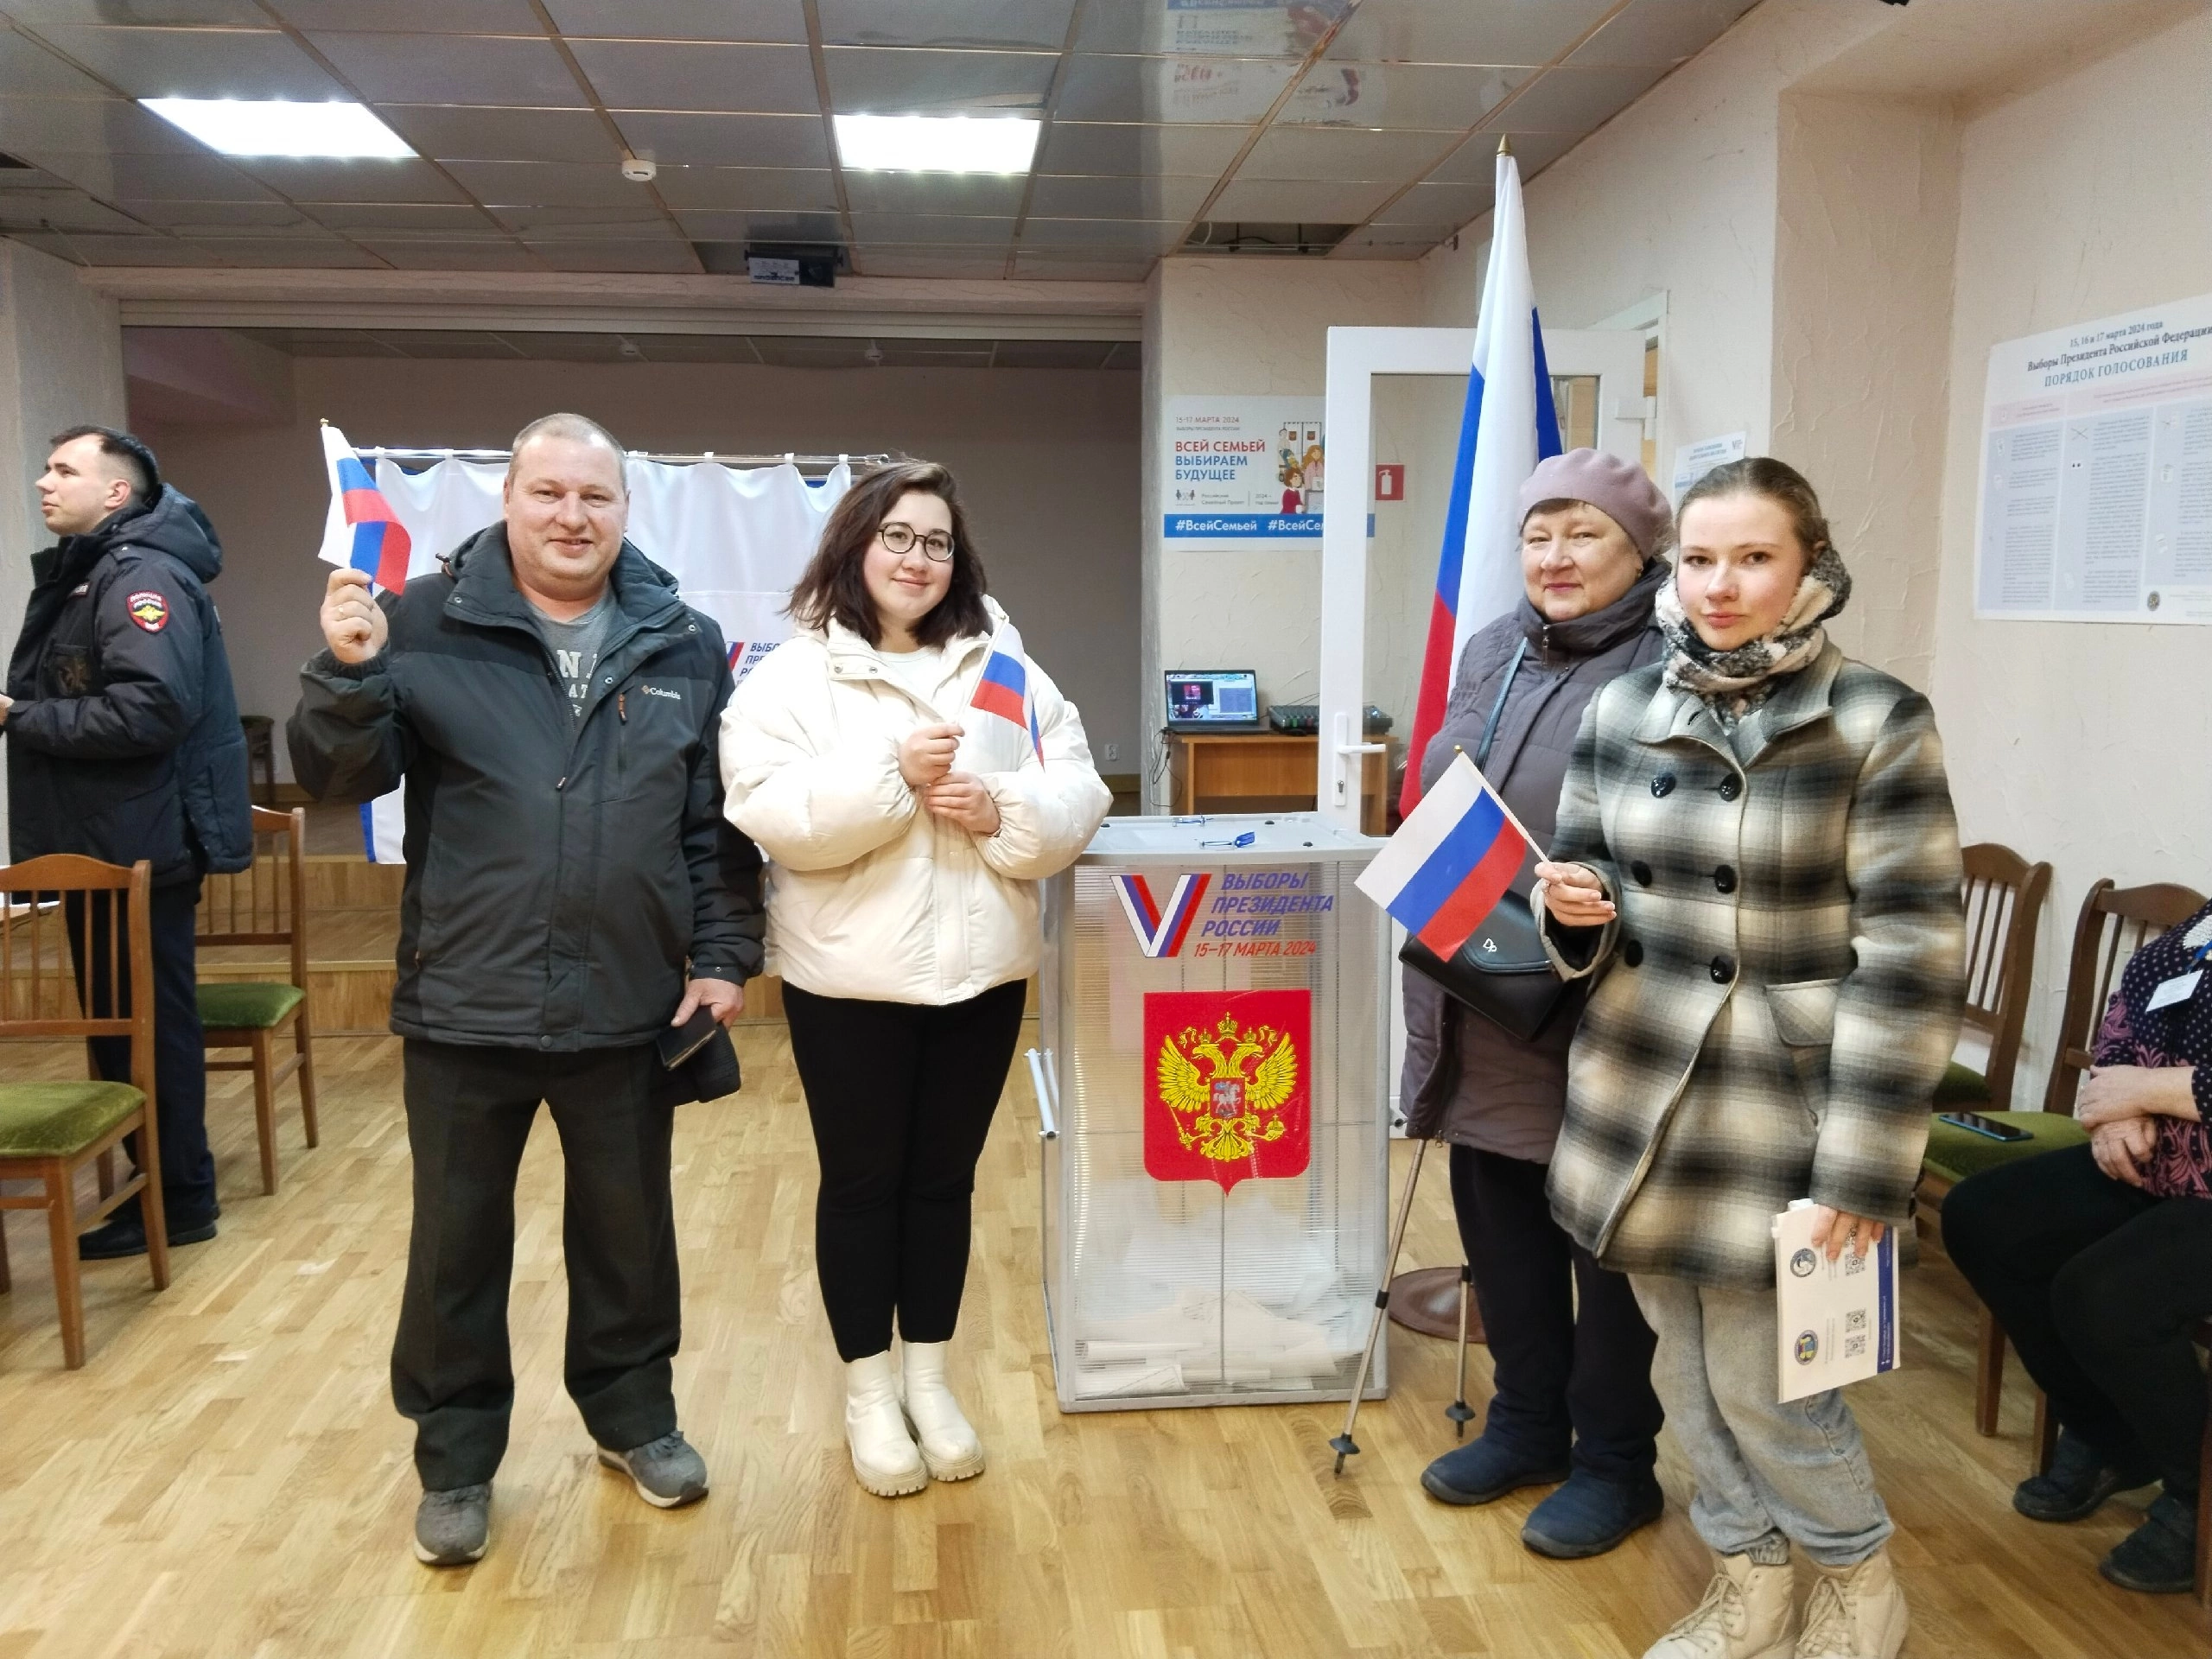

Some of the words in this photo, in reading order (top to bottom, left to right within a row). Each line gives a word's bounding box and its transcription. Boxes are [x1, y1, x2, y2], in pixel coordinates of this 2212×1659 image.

[2082, 335, 2089, 346] 16
[2096, 332, 2105, 341] 17
[2106, 328, 2126, 340] марта
[2128, 322, 2145, 335] 2024
[2146, 321, 2164, 332] года
[2027, 358, 2058, 372] Выборы
[2060, 346, 2107, 366] Президента
[2109, 334, 2160, 355] Российской
[2044, 368, 2095, 387] ПОРЯДОК
[2098, 349, 2189, 378] ГОЛОСОВАНИЯ
[1175, 439, 1209, 452] ВСЕЙ
[1213, 439, 1265, 452] СЕМЬЕЙ
[1175, 455, 1248, 466] ВЫБИРАЕМ
[1175, 469, 1236, 481] БУДУЩЕЕ
[1176, 519, 1257, 531] #ВсейСемьей
[1221, 872, 1309, 890] ВЫБОРЫ
[1211, 895, 1334, 914] ПРЕЗИДЕНТА
[1201, 918, 1281, 937] РОССИИ
[1233, 941, 1281, 957] МАРТА
[1283, 940, 1316, 955] 2024
